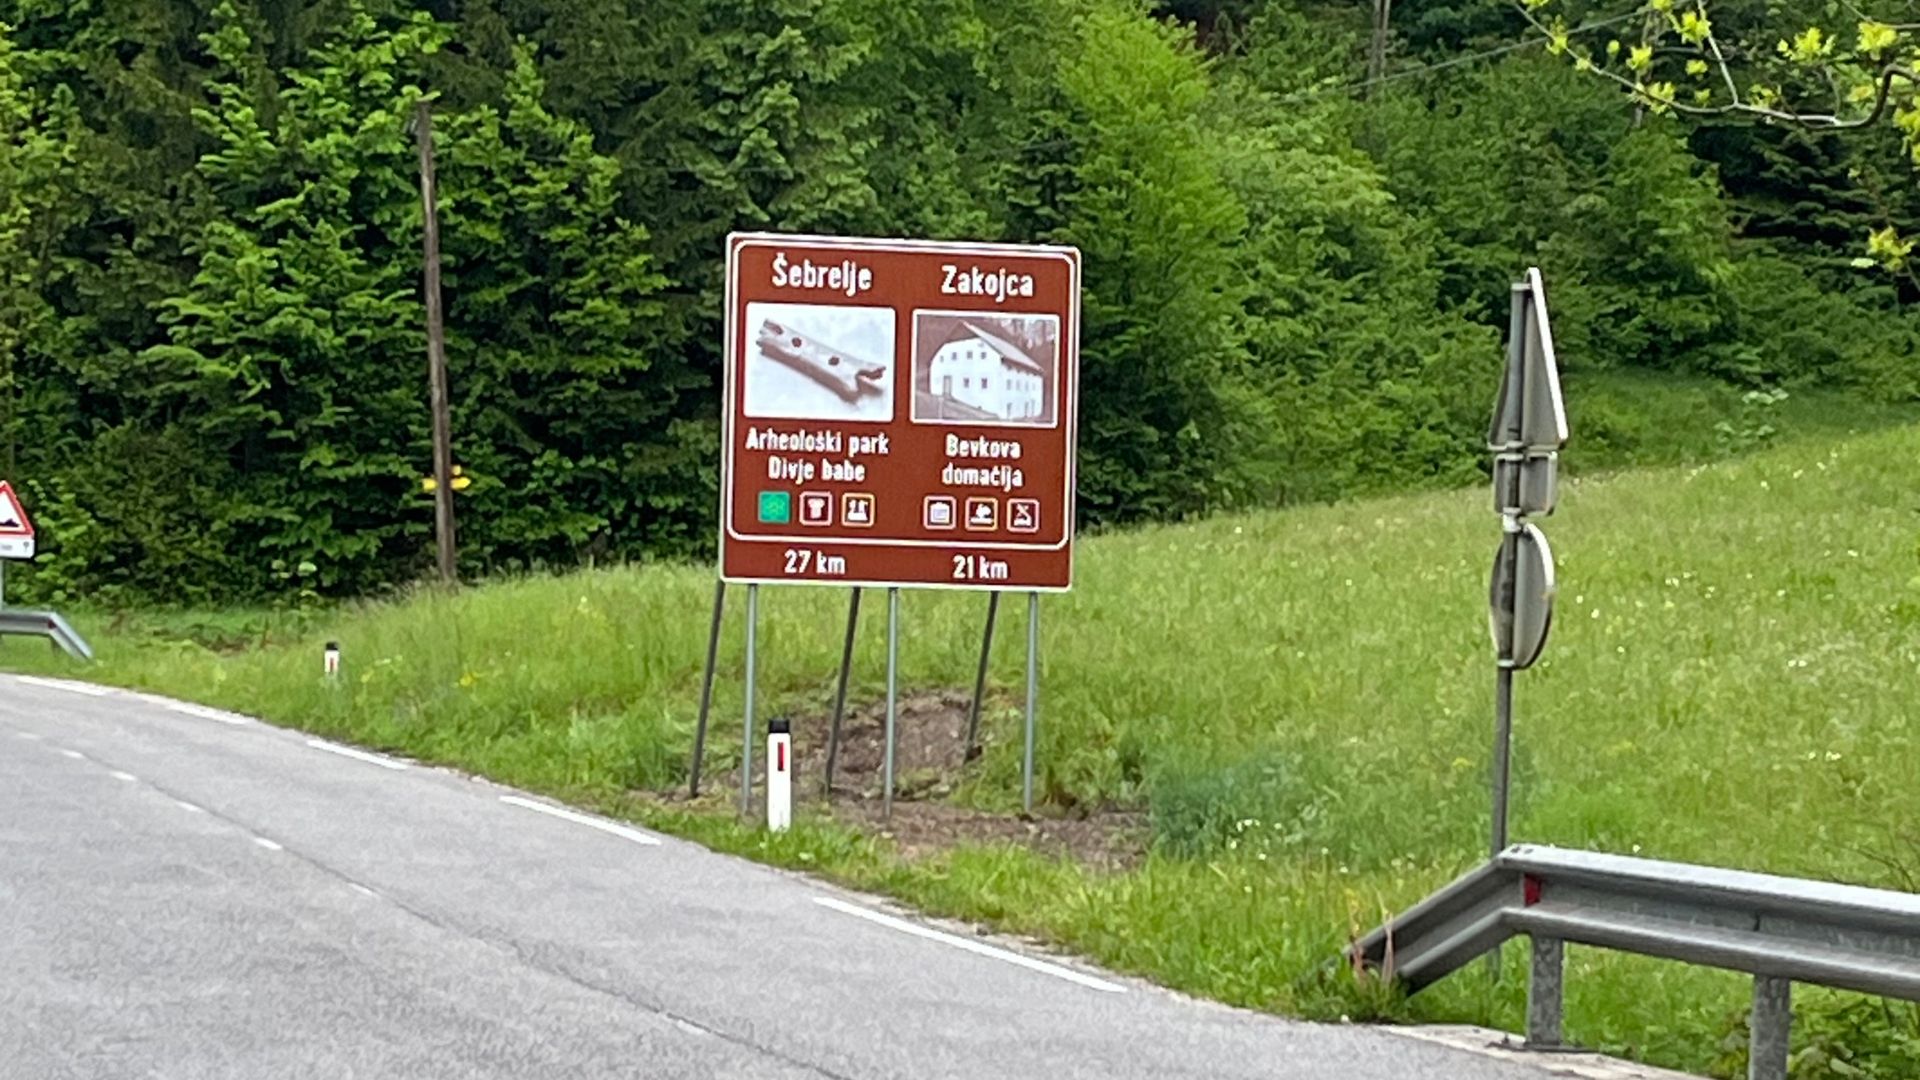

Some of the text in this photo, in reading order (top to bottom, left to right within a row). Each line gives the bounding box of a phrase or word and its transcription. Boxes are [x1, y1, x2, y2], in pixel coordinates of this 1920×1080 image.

[771, 252, 872, 297] Šebrelje
[941, 264, 1034, 302] Zakojca
[745, 427, 889, 457] Arheološki park
[945, 433, 1021, 459] Bevkova
[768, 455, 865, 484] Divje babe
[942, 461, 1023, 492] domačija
[784, 549, 846, 575] 27 km
[953, 554, 1008, 580] 21 km
